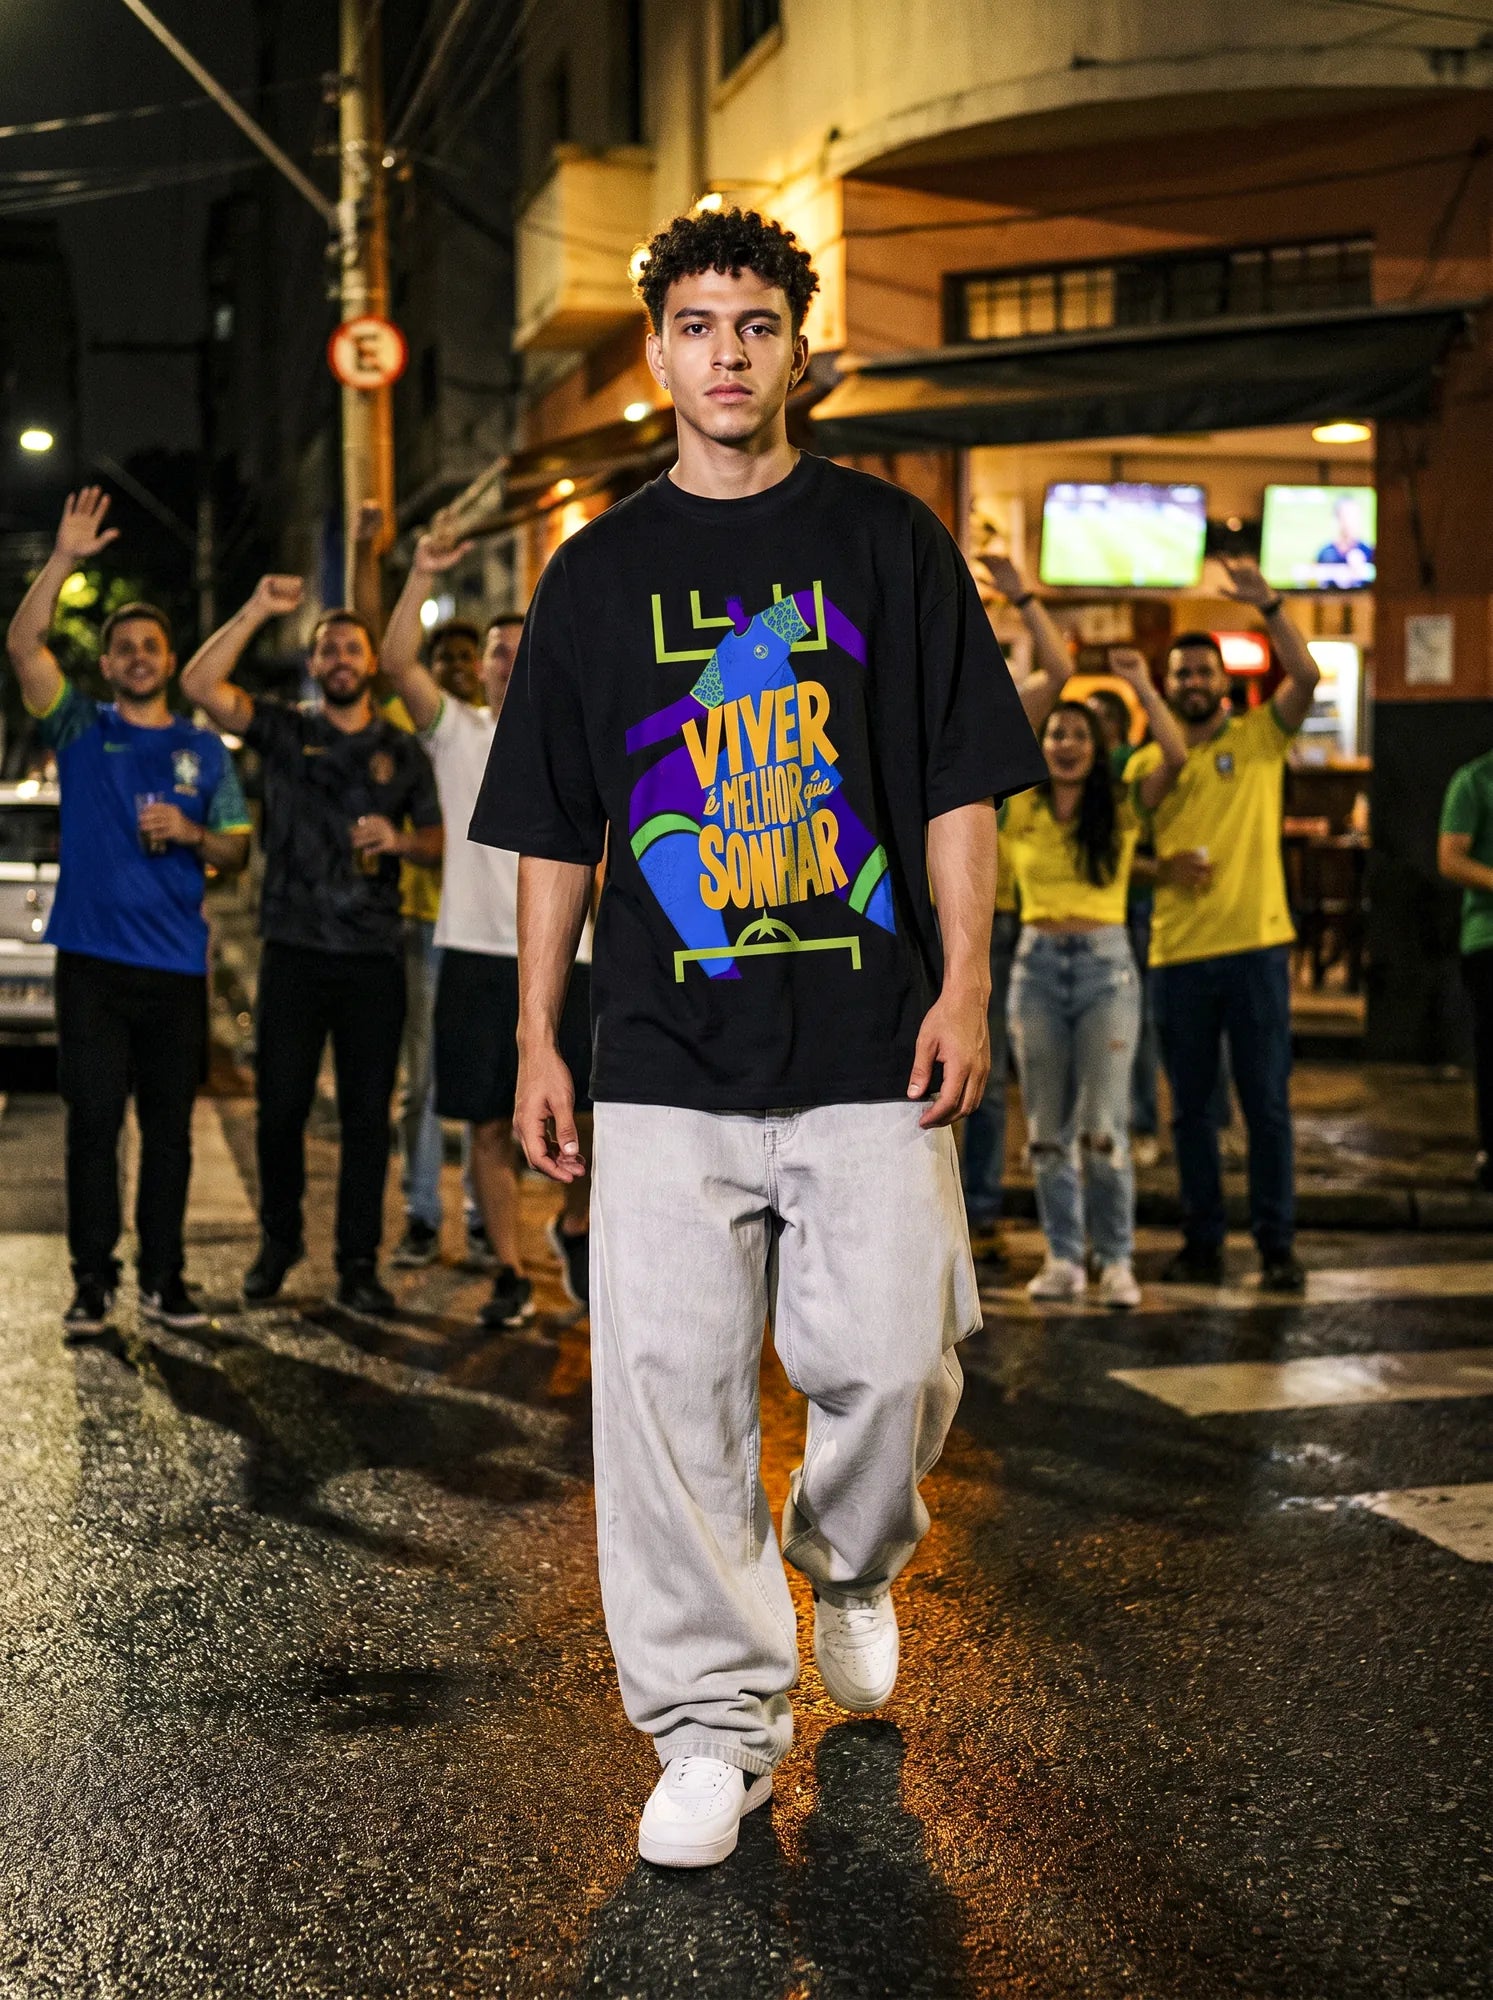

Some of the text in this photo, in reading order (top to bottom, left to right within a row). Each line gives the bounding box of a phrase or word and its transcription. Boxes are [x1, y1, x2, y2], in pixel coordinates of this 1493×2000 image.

[354, 334, 380, 373] E
[681, 680, 839, 789] VIVER
[703, 787, 720, 816] é
[722, 762, 807, 832] MELHOR
[698, 808, 849, 911] SONHAR
